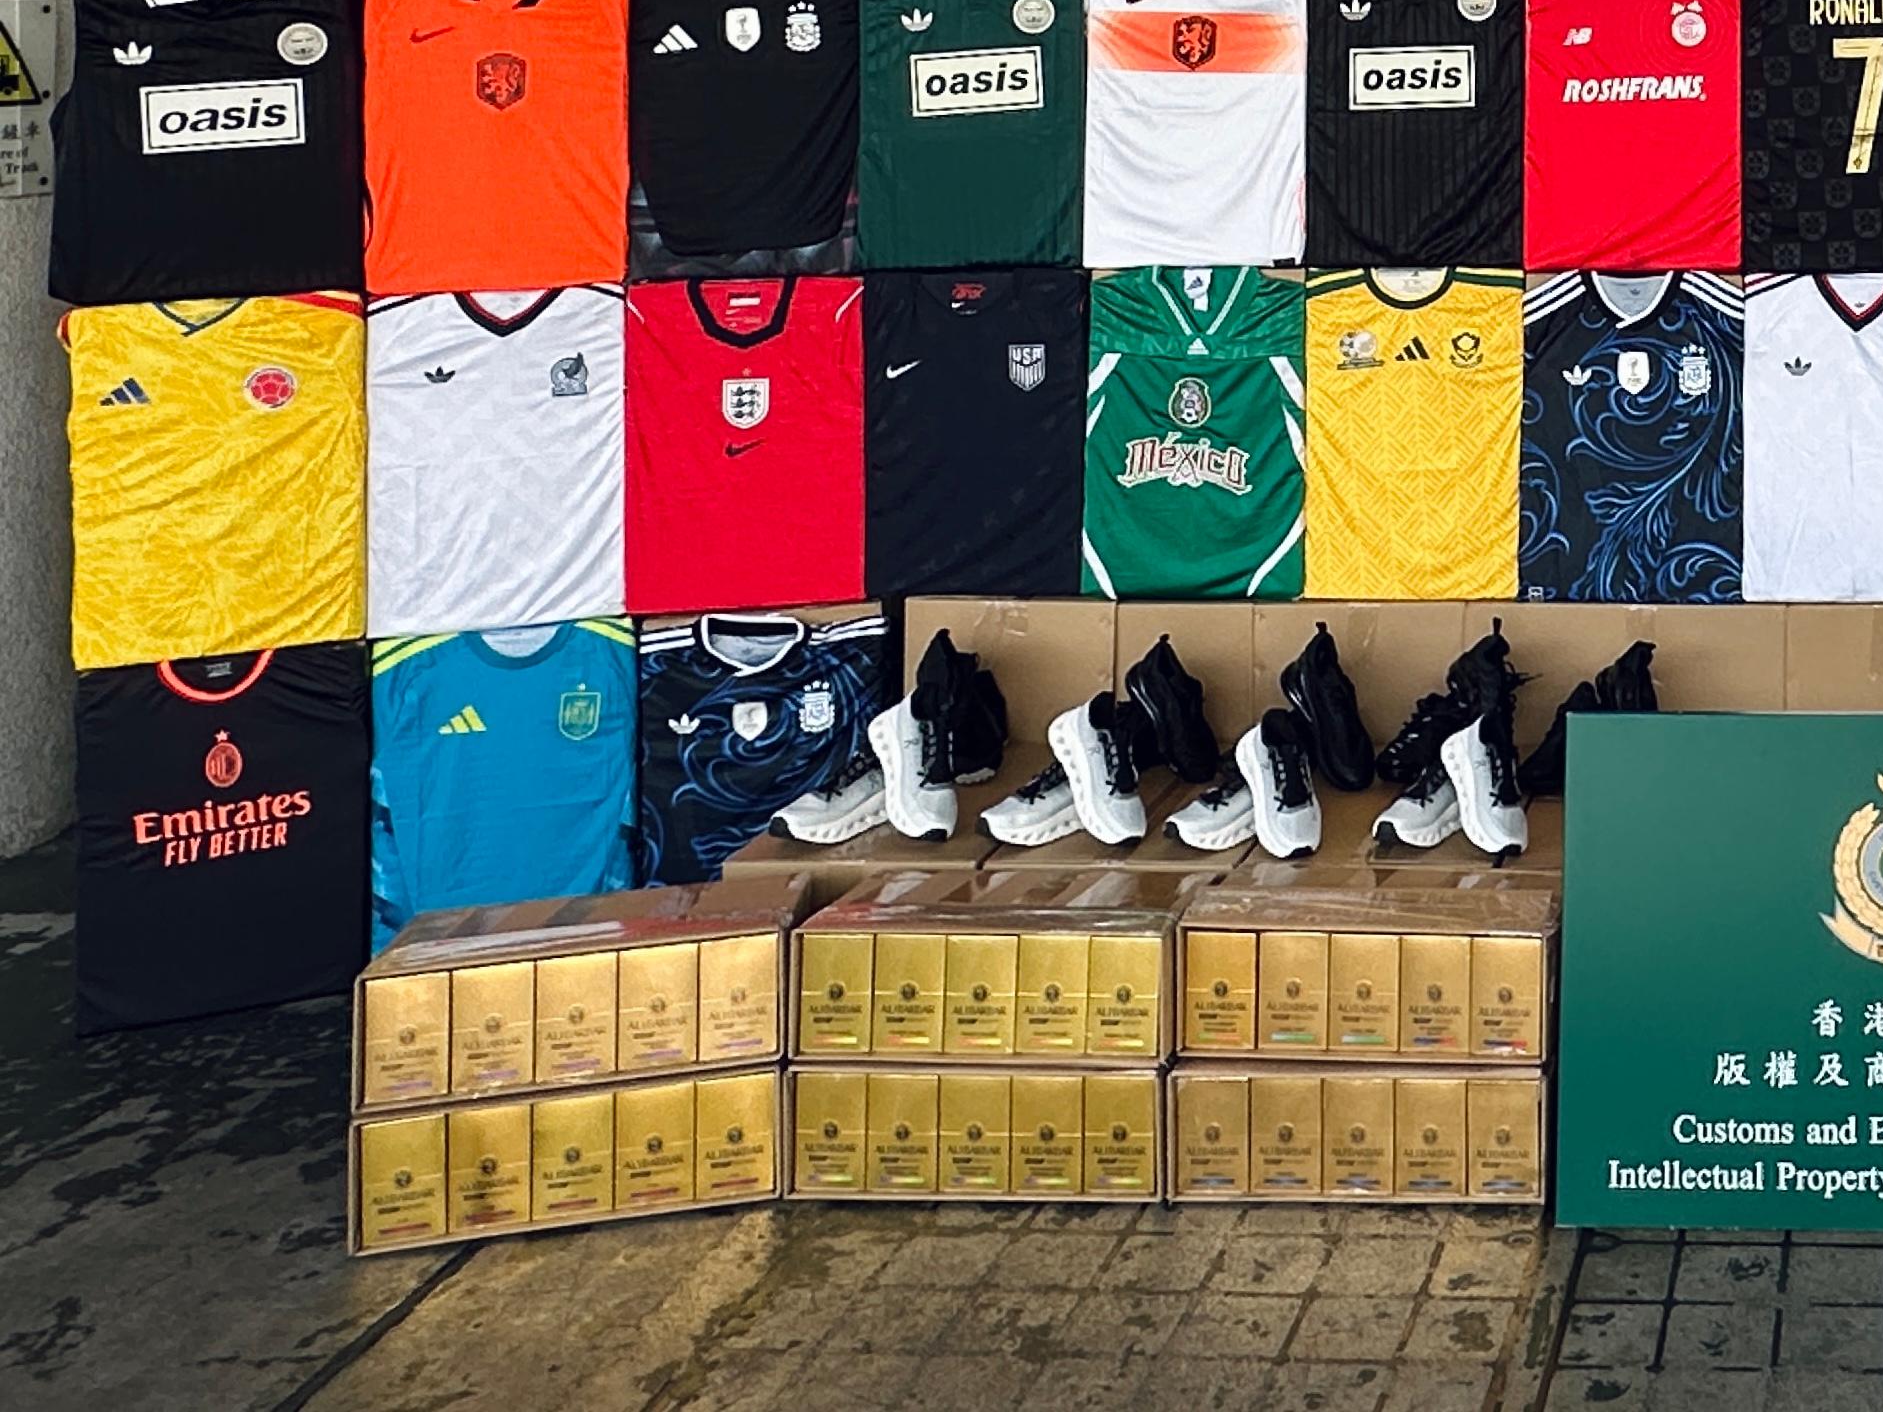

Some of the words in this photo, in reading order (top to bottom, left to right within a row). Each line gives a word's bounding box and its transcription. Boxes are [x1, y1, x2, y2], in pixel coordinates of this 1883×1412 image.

[925, 61, 1030, 97] oasis
[1362, 58, 1463, 92] oasis
[159, 97, 288, 135] oasis
[1012, 347, 1042, 365] USA
[132, 790, 312, 845] Emirates
[164, 835, 202, 868] FLY
[208, 821, 288, 859] BETTER
[1672, 1114, 1795, 1145] Customs
[1806, 1115, 1858, 1146] and
[1608, 1159, 1765, 1191] Intellectual
